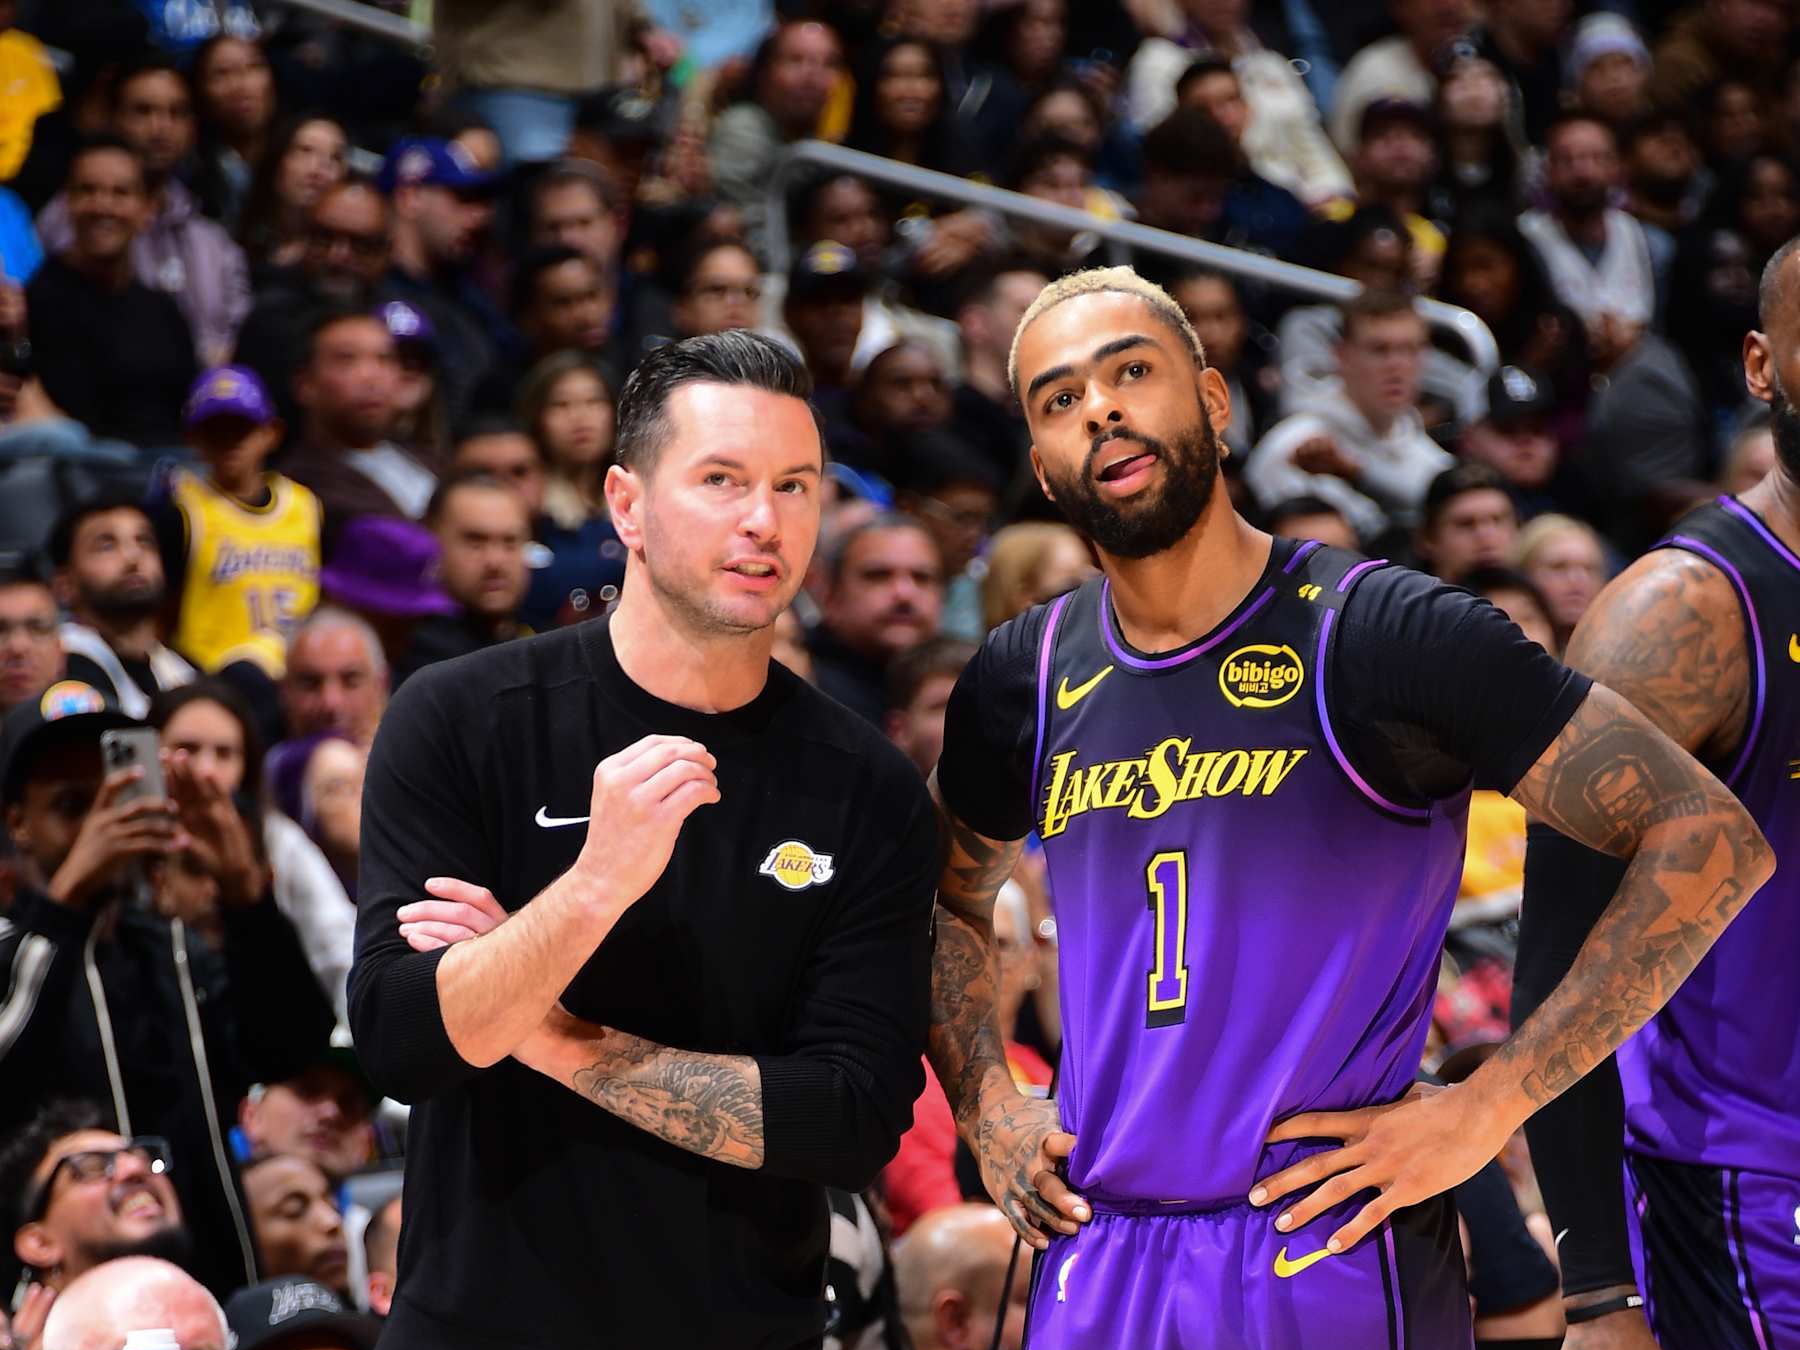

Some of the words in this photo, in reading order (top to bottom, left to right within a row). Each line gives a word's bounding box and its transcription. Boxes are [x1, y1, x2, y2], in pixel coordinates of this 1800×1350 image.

[1227, 661, 1299, 689] bibigo
[1238, 682, 1270, 693] 비비고
[1146, 851, 1188, 1012] 1
